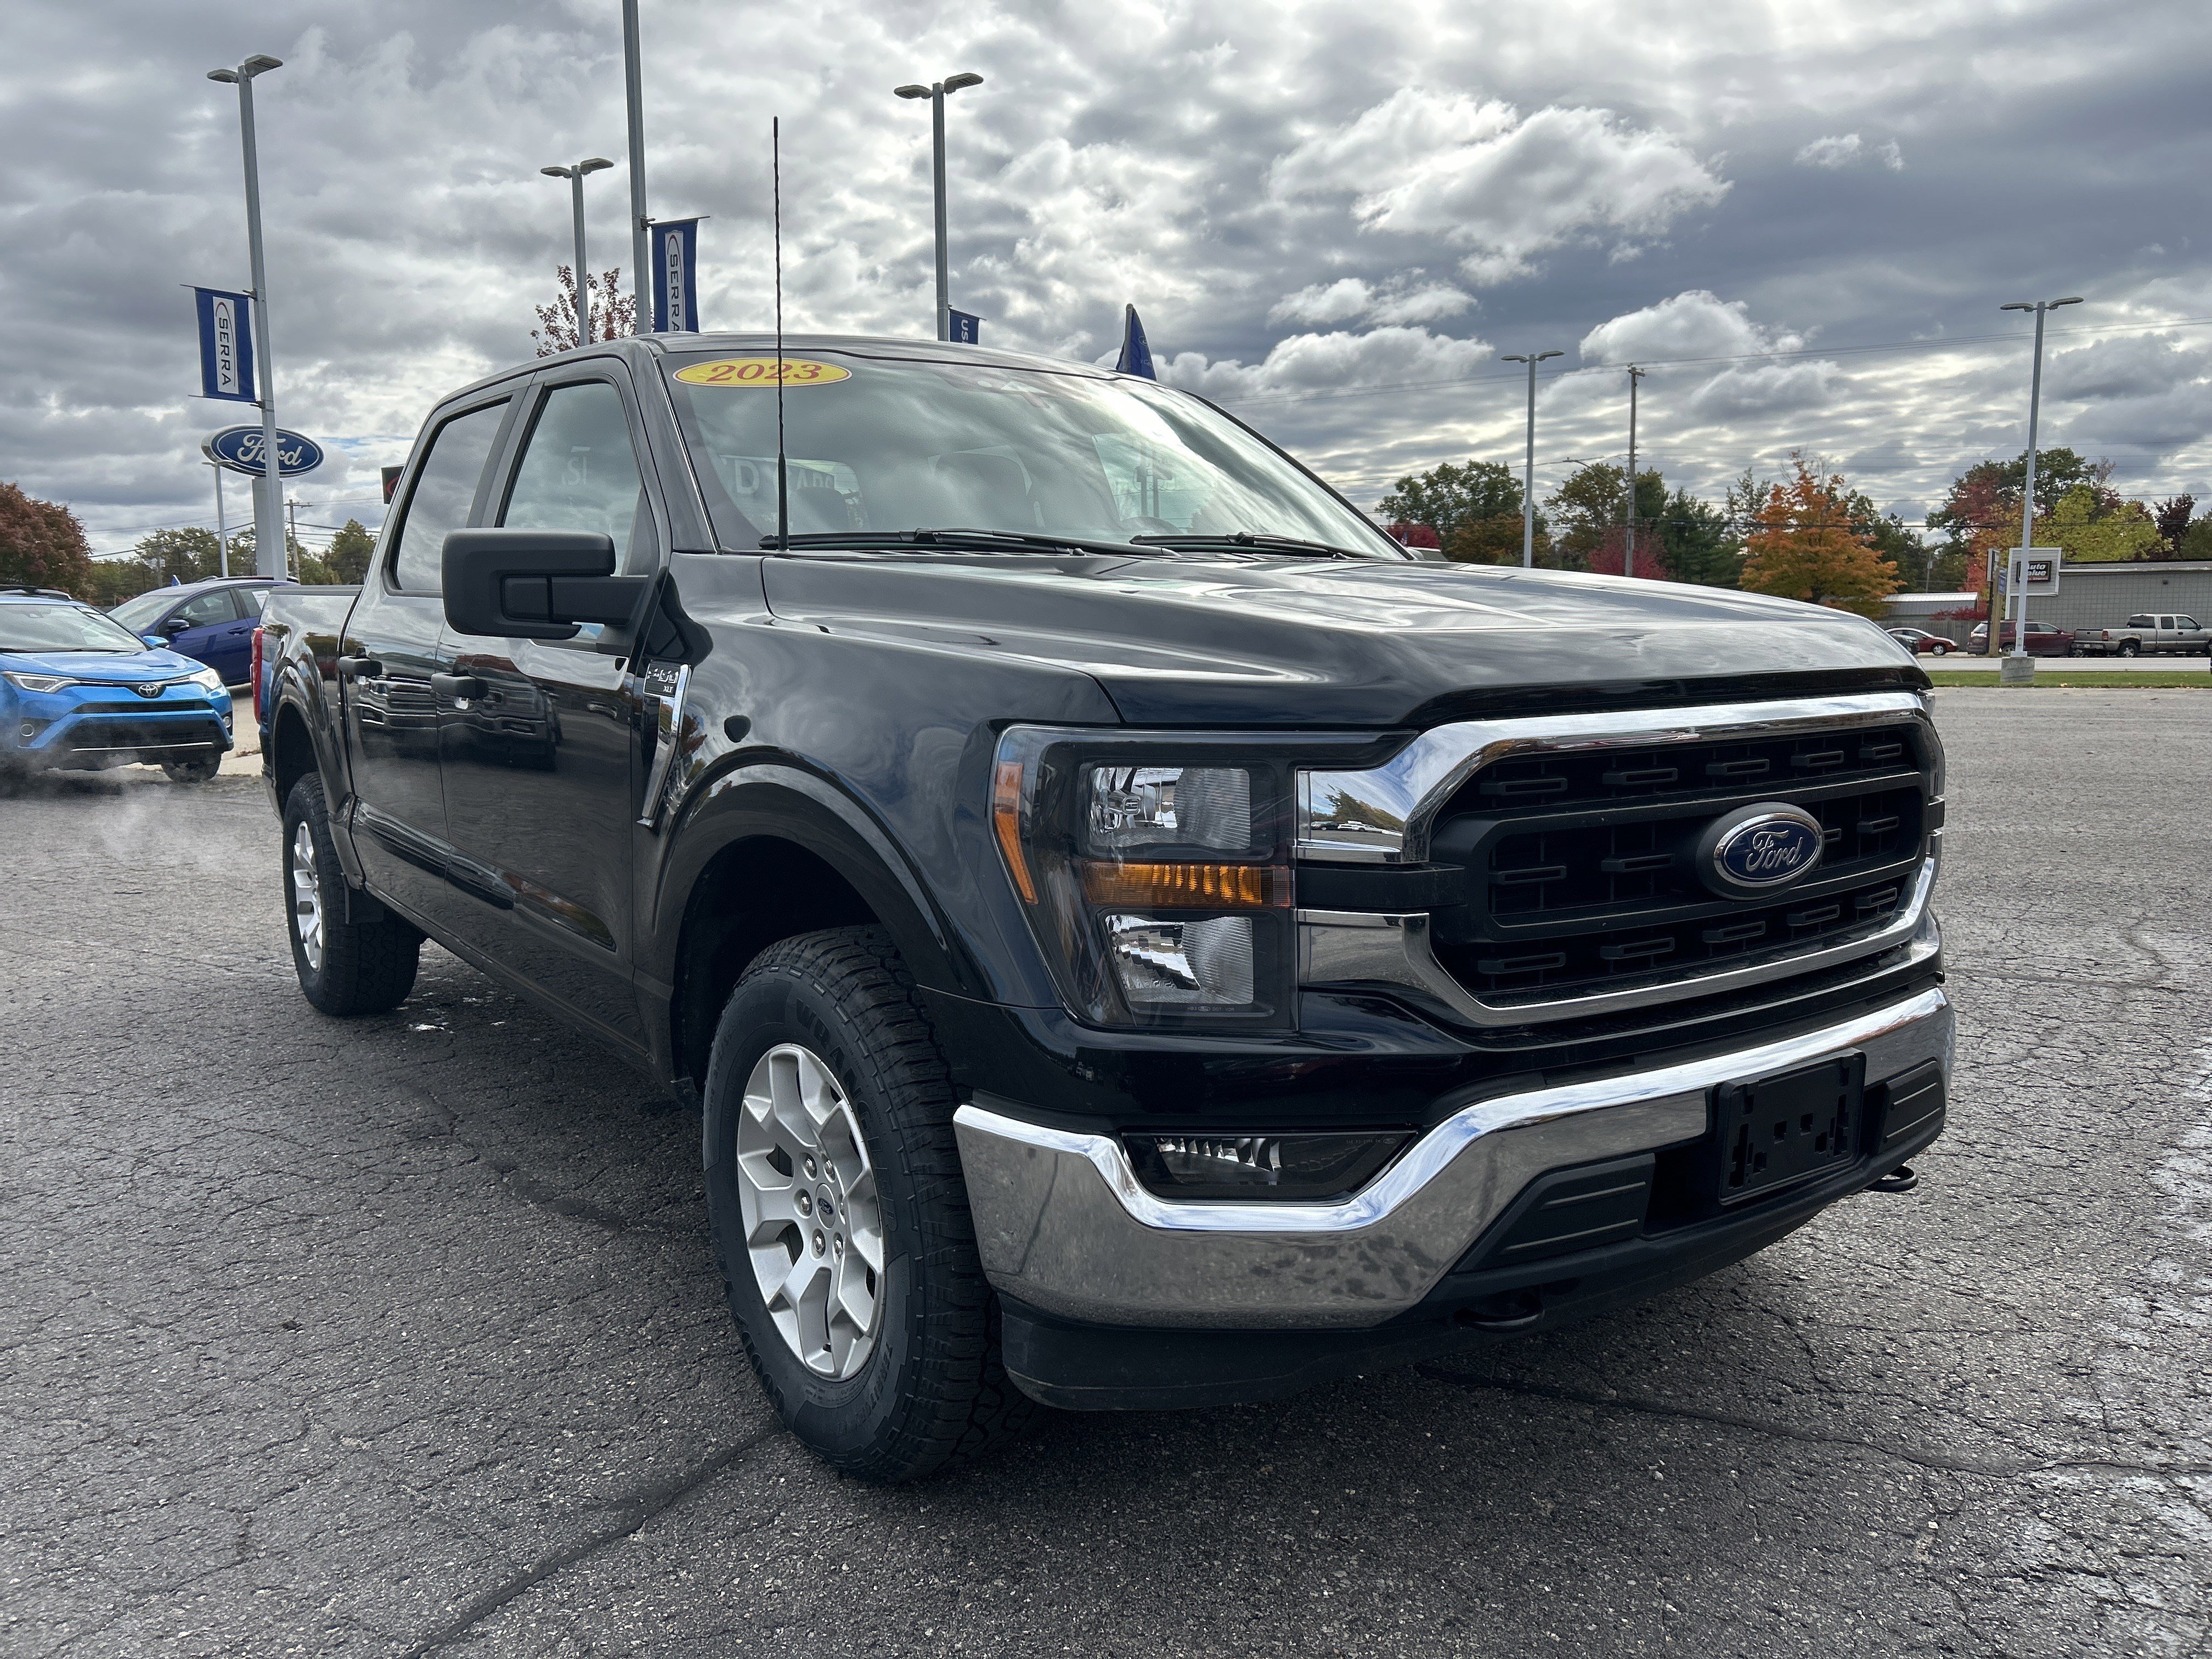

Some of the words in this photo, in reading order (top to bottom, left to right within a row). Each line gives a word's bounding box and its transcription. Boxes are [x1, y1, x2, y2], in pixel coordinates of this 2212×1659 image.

[670, 254, 680, 331] SERRA
[219, 317, 232, 386] SERRA
[706, 364, 822, 382] 2023
[1746, 830, 1803, 872] Ford
[796, 998, 898, 1232] WRANGLER
[820, 1200, 830, 1213] Ford
